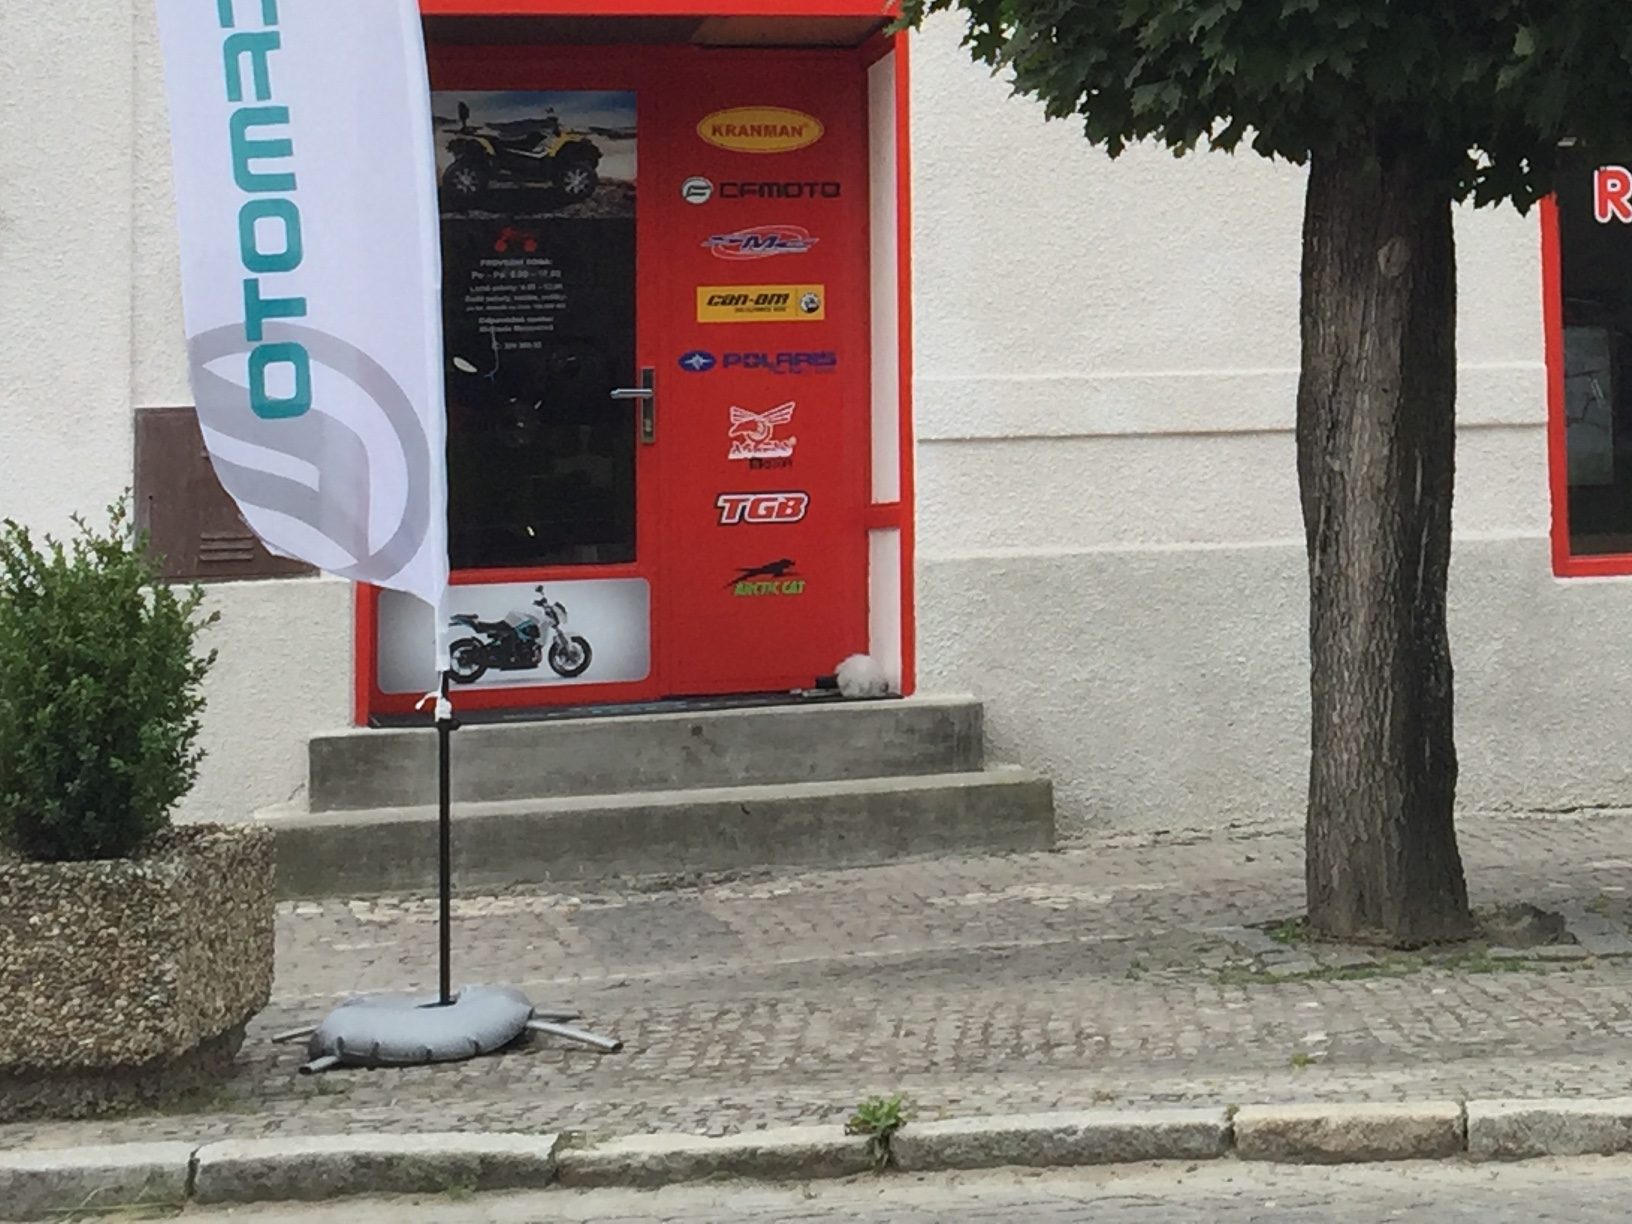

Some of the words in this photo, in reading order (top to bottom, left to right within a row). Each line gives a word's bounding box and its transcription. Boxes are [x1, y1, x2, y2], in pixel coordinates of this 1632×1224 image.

[710, 123, 803, 139] KRANMAN
[719, 181, 841, 198] CFMOTO
[722, 352, 837, 367] POLARIS
[720, 494, 807, 522] TGB
